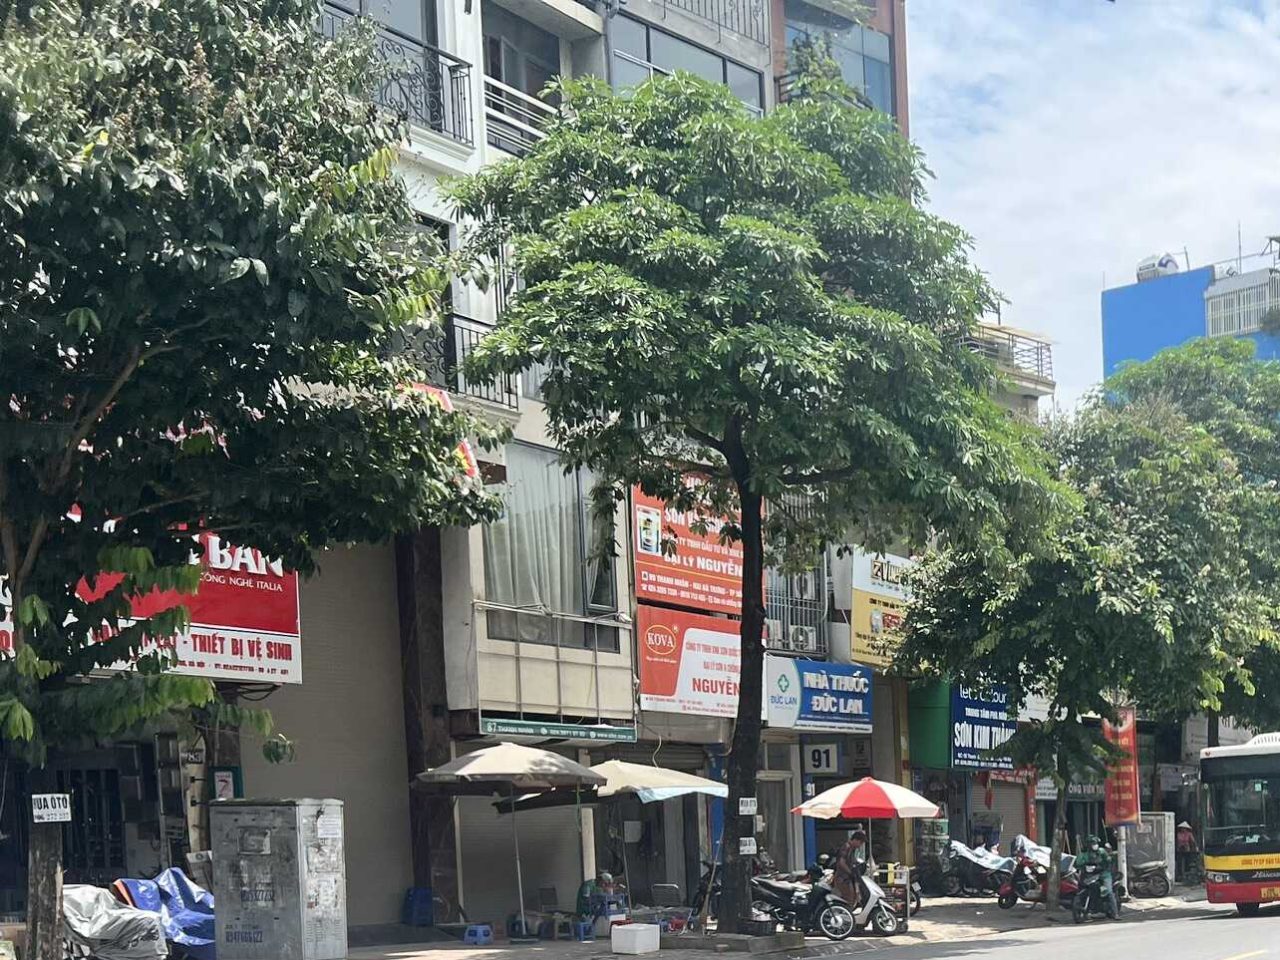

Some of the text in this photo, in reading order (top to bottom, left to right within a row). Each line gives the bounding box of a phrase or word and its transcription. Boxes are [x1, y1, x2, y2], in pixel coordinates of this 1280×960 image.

[257, 582, 283, 592] ITALIA
[191, 632, 292, 661] THIẾT BỊ VỆ SINH
[647, 632, 674, 648] KOVA
[803, 669, 869, 693] NHÀ THUỐC
[785, 696, 798, 706] LAN
[811, 693, 864, 715] ĐỨC LAN
[486, 722, 497, 733] 87
[954, 721, 973, 748] SƠN
[973, 725, 990, 750] KIM
[812, 749, 831, 769] 91
[805, 783, 816, 797] 91
